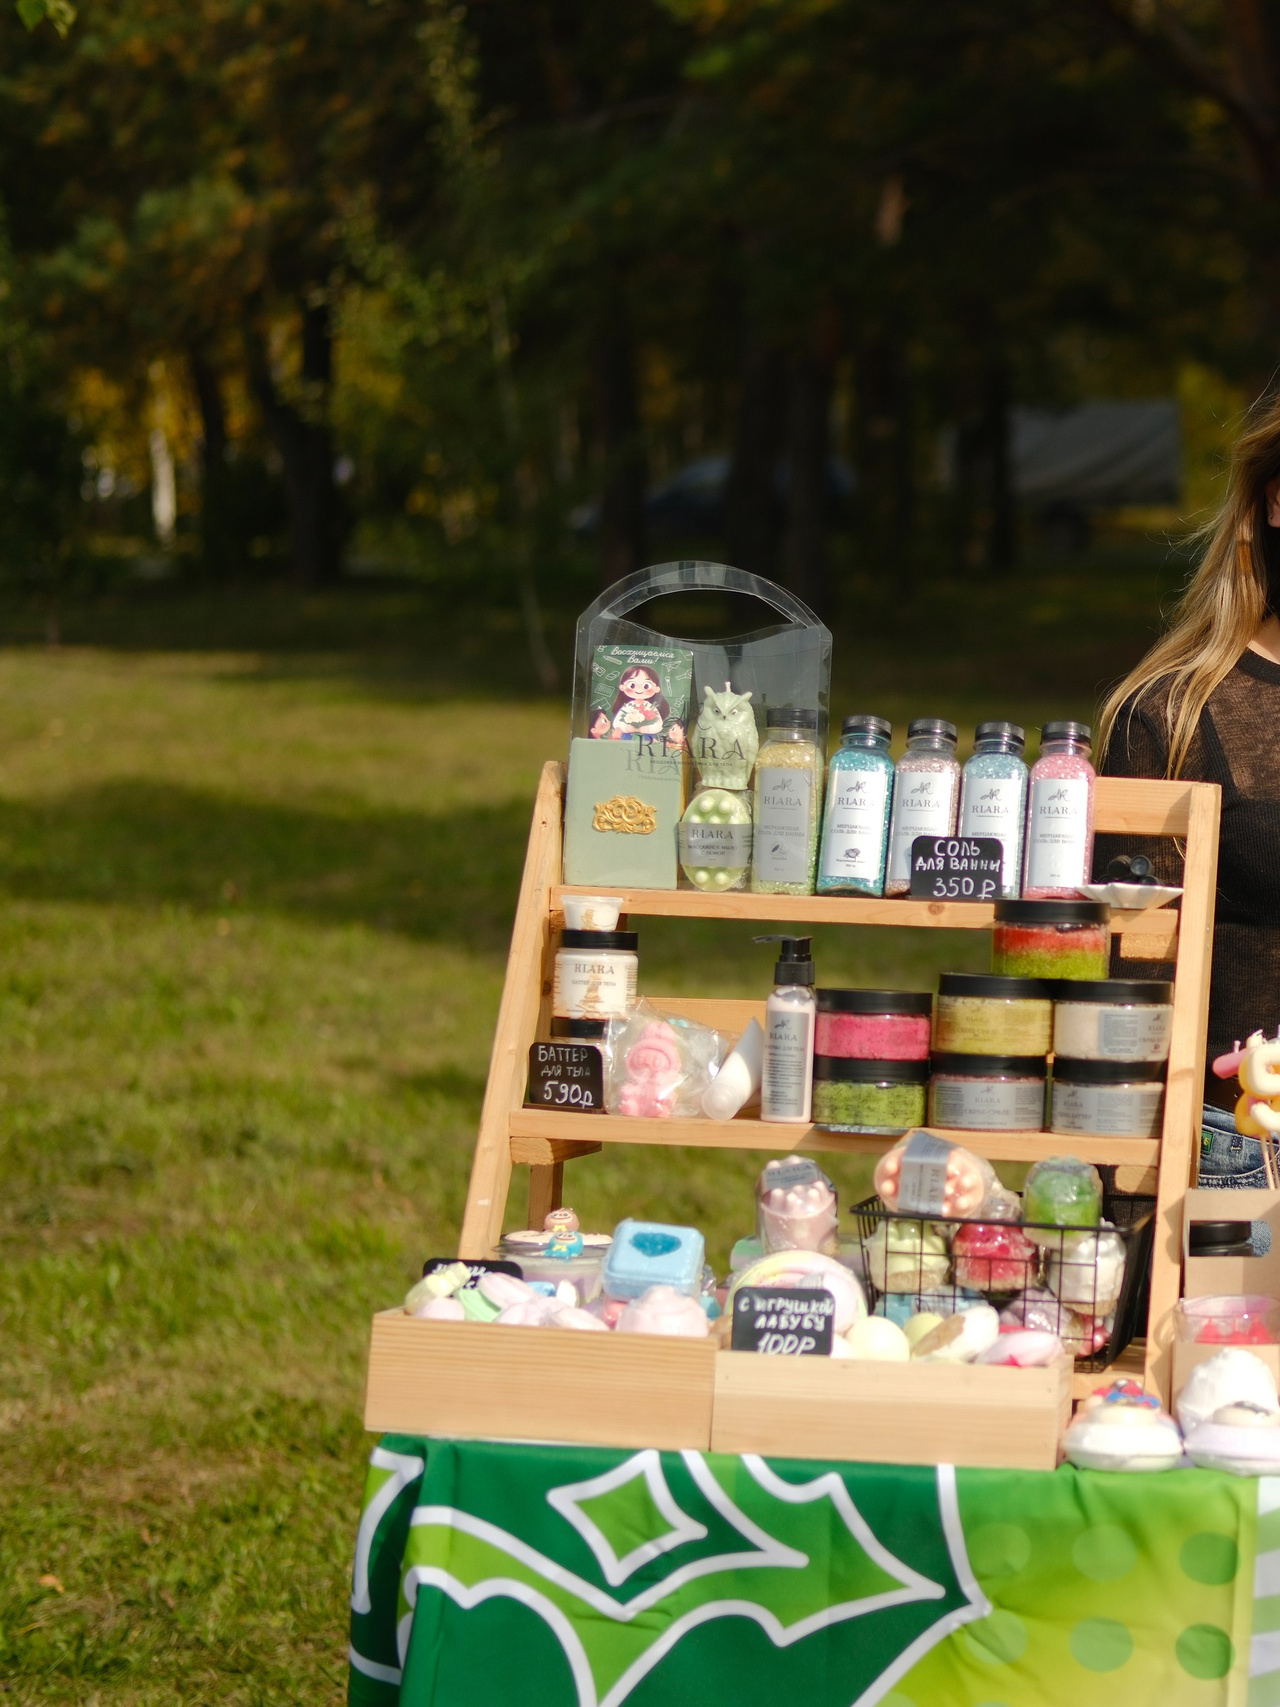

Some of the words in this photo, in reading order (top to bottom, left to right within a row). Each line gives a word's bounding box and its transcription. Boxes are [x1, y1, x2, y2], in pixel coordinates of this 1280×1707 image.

[611, 646, 676, 658] Восхищаемся
[627, 655, 660, 665] Вами!
[637, 734, 748, 760] RIARA
[764, 796, 802, 806] RIARA
[902, 799, 940, 809] RIARA
[972, 805, 1009, 814] RIARA
[1039, 806, 1077, 815] RIARA
[692, 829, 734, 840] RIARA
[934, 839, 980, 857] СОЛЬ
[915, 856, 944, 871] ДЛЯ
[950, 857, 1001, 872] ВАННЫ
[933, 877, 974, 897] 350
[574, 964, 615, 975] RIARA
[538, 1045, 588, 1062] БАТТЕР
[541, 1065, 562, 1077] ДЛЯ
[738, 1296, 750, 1312] С
[754, 1297, 834, 1316] ИГРУШКОЙ
[754, 1313, 825, 1332] ЛАБУБУ
